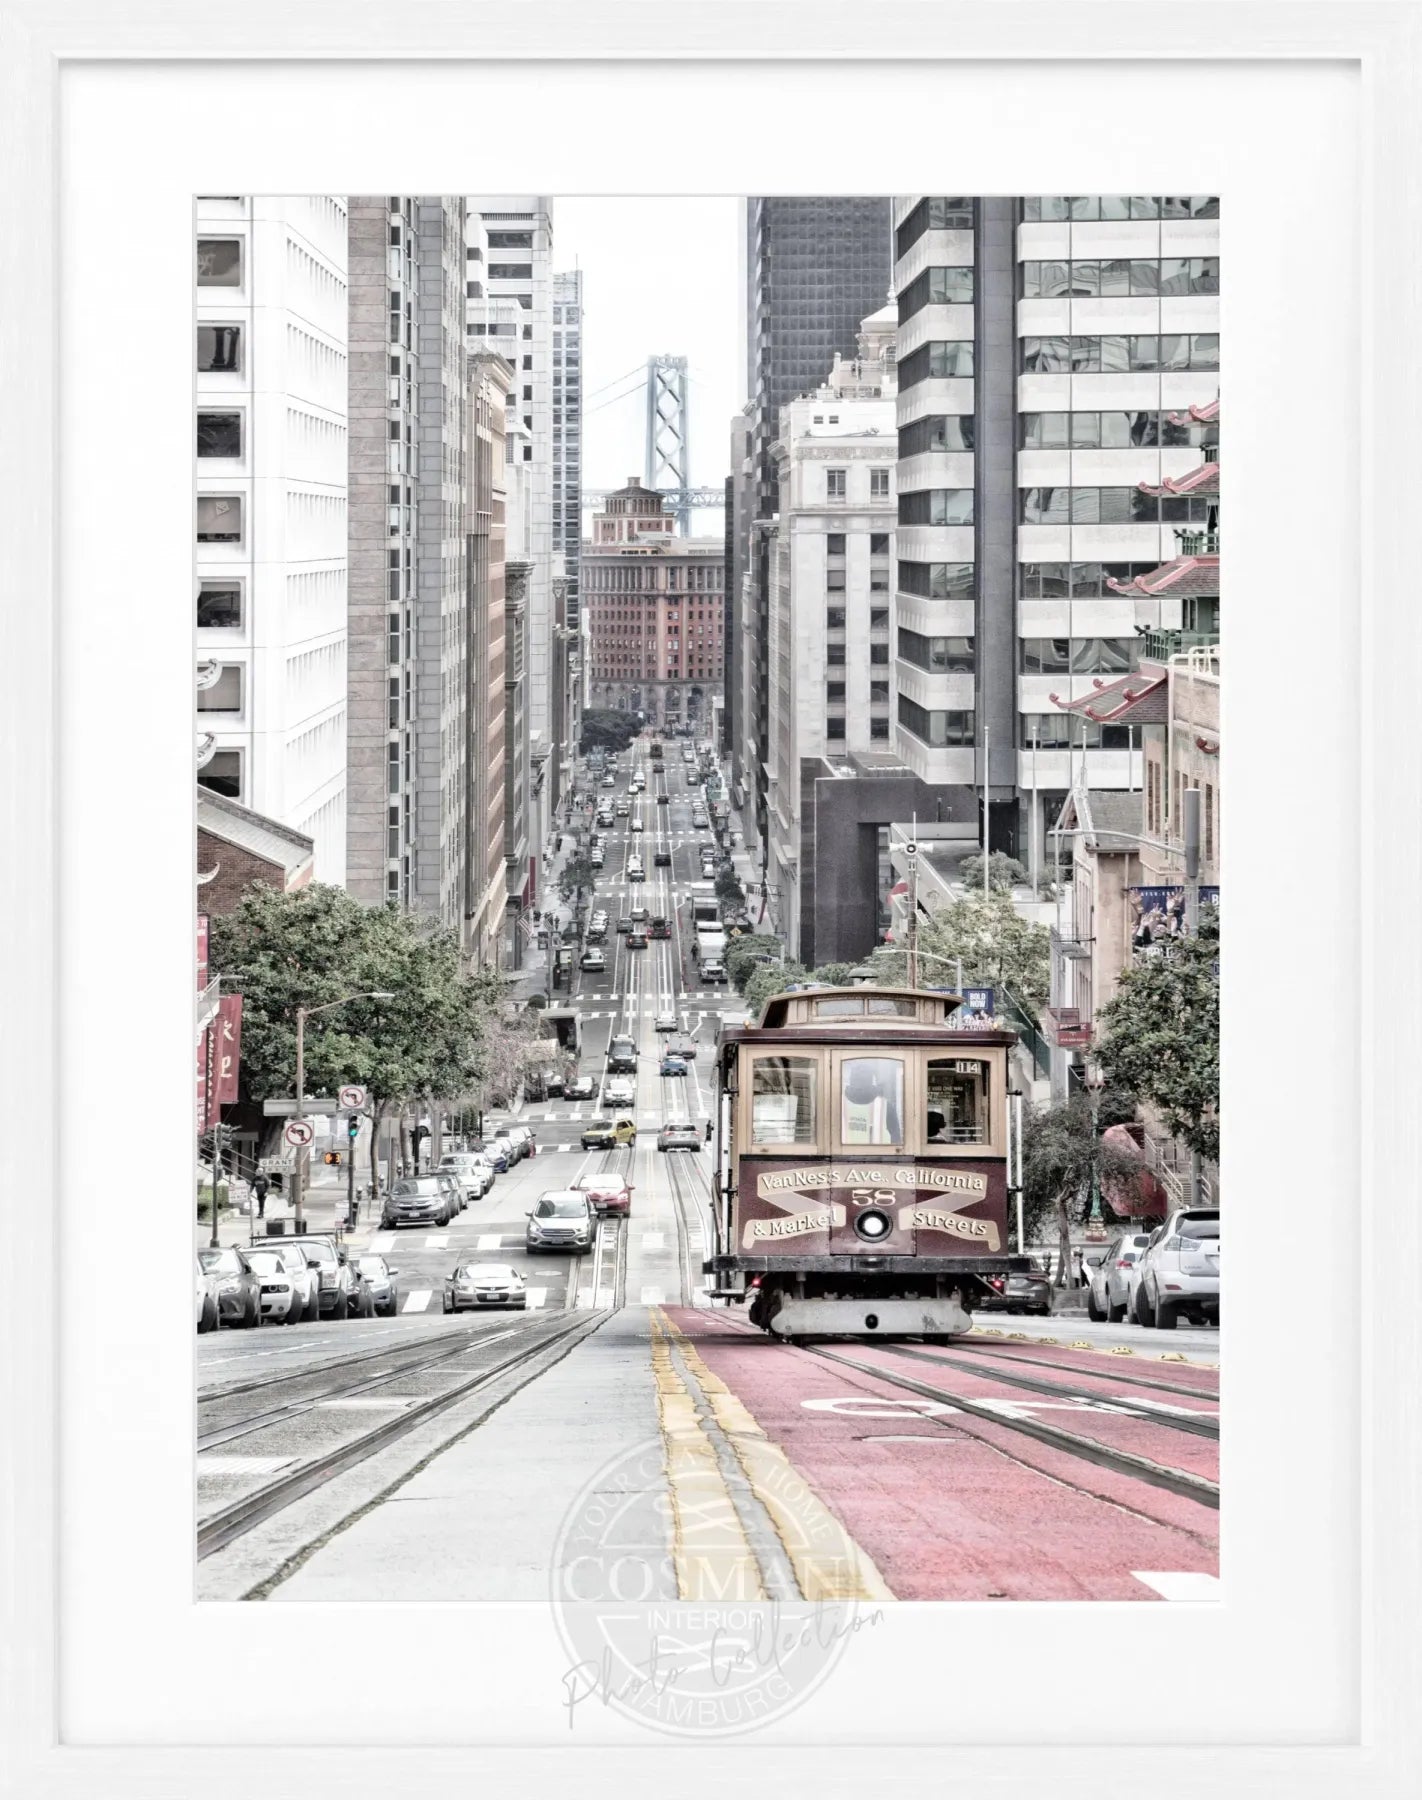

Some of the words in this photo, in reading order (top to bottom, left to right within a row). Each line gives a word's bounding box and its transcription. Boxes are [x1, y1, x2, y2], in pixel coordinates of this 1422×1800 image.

[969, 992, 987, 1000] BOLD
[969, 1000, 986, 1008] NOW
[261, 1159, 293, 1168] GRANT
[894, 1169, 984, 1190] California
[852, 1189, 896, 1207] 58
[753, 1222, 766, 1236] &
[769, 1207, 838, 1236] Market
[912, 1210, 988, 1236] Streets
